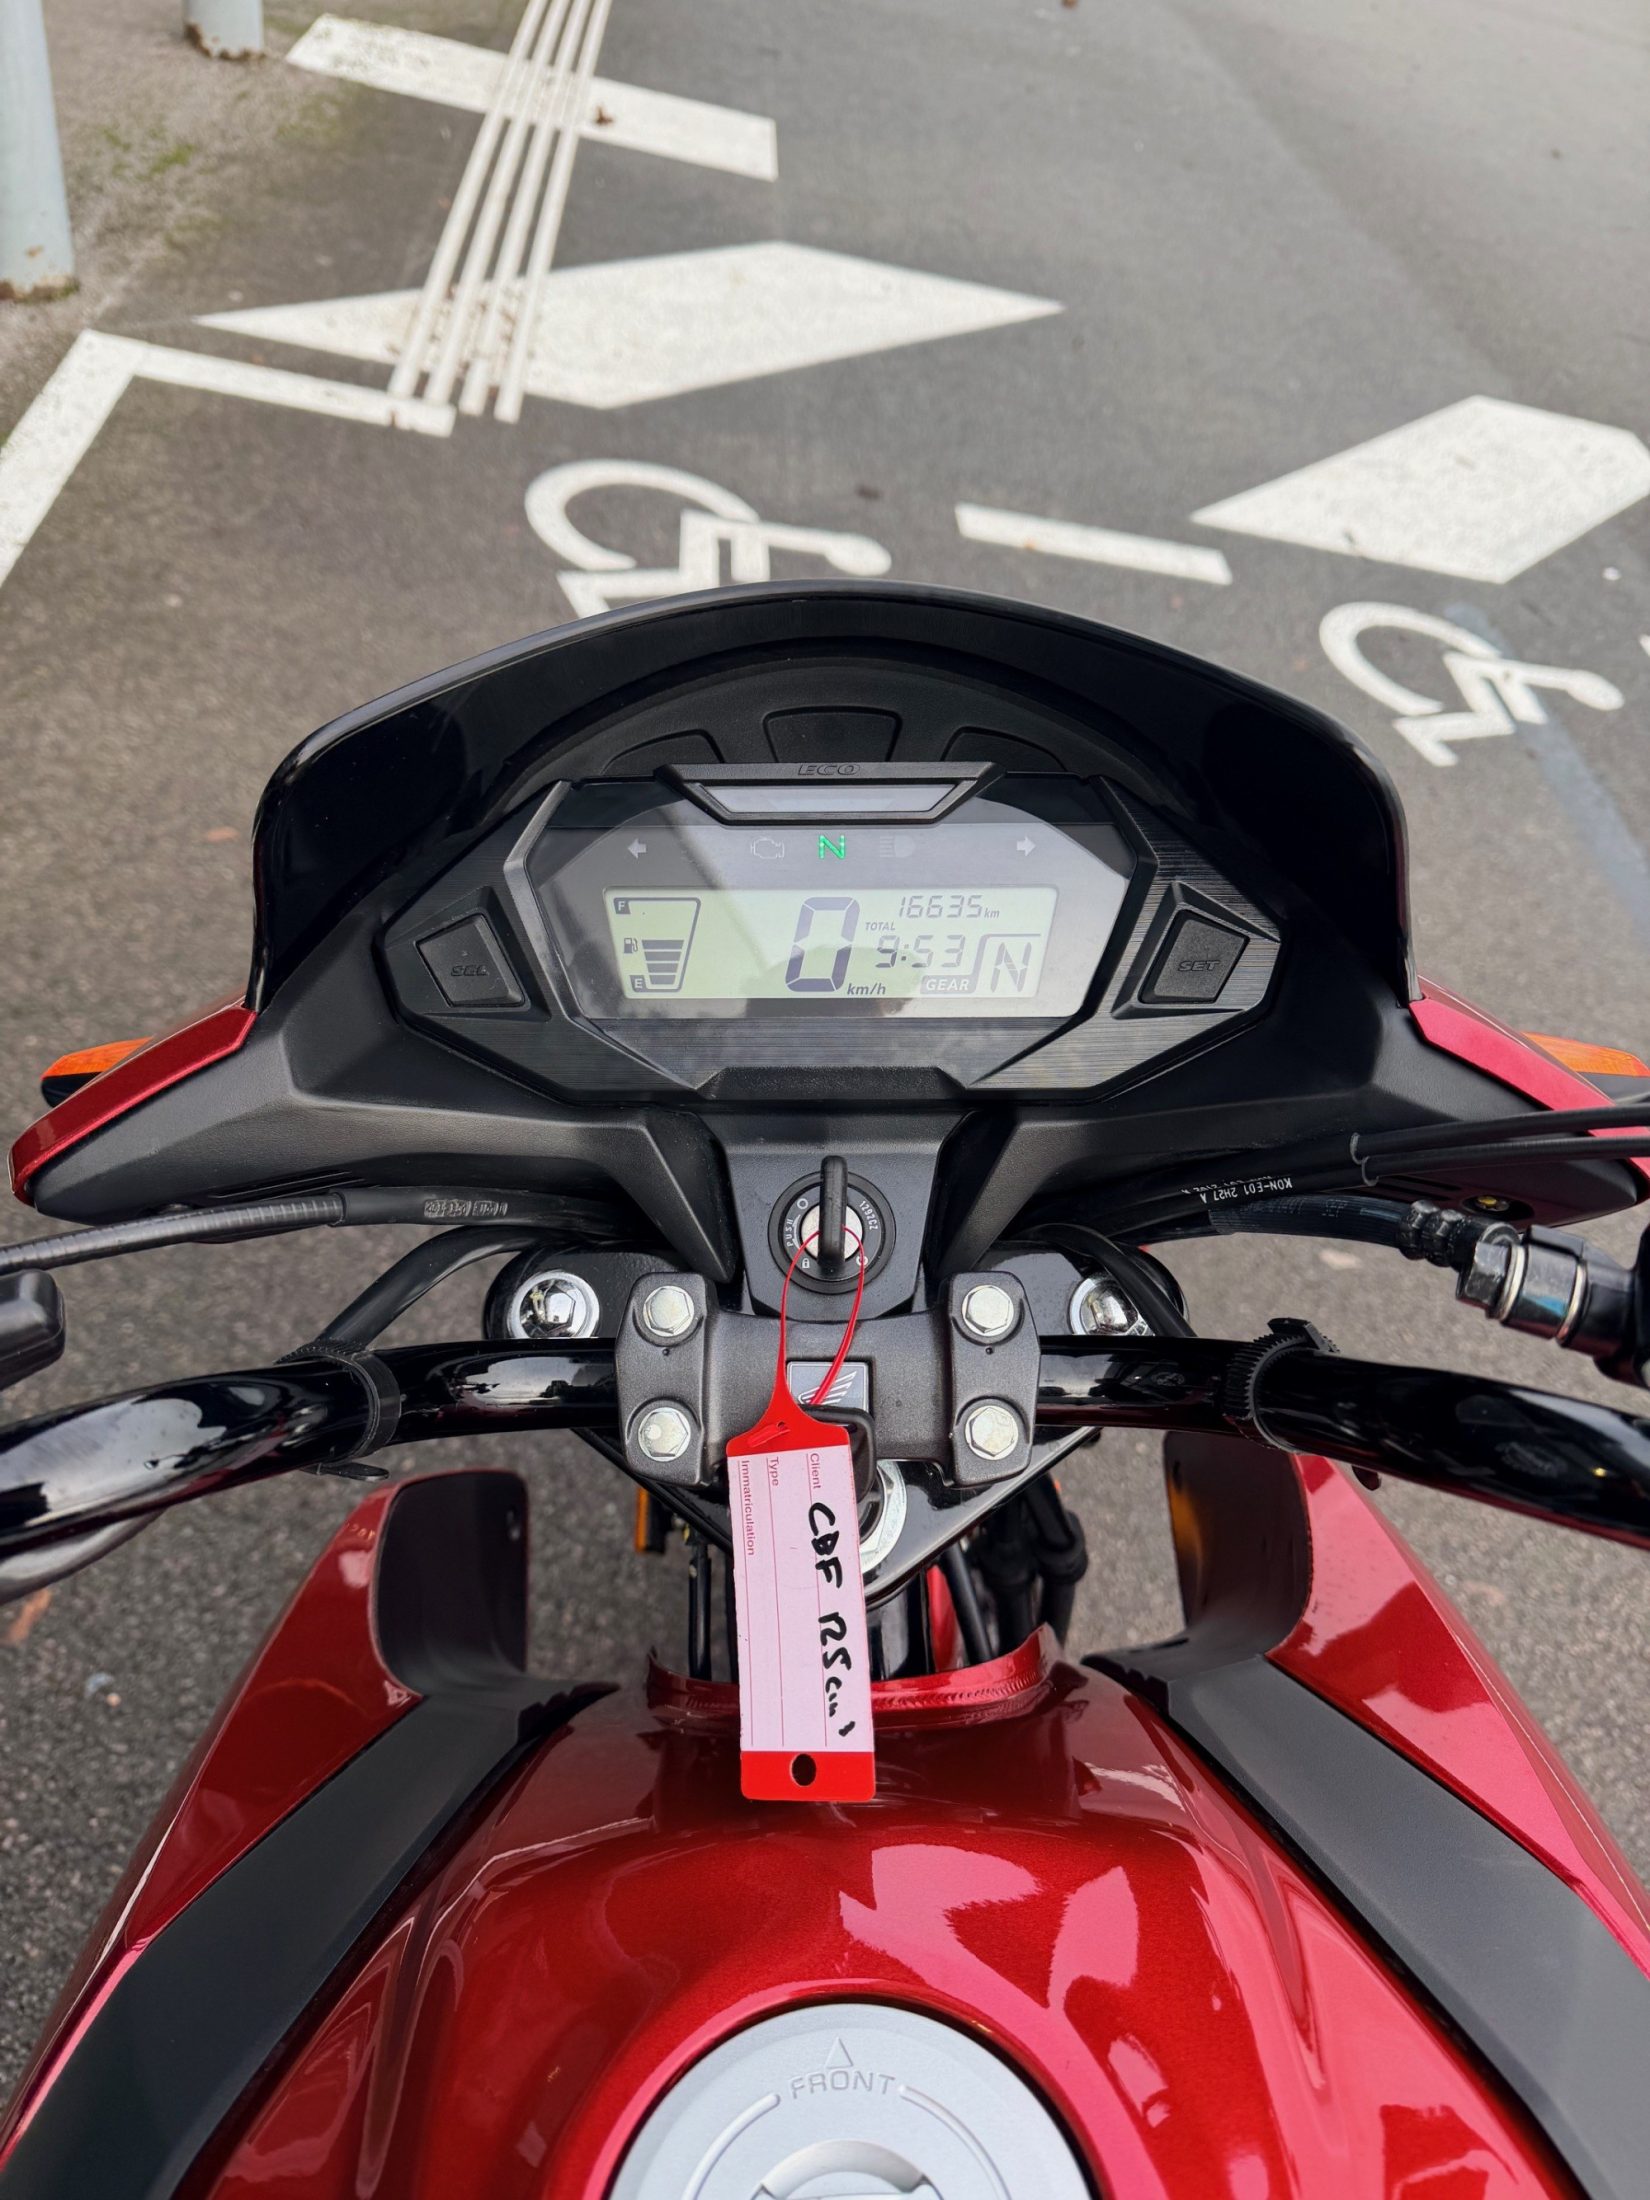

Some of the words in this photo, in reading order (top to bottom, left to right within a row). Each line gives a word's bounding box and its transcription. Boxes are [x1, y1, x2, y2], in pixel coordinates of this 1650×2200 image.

[798, 763, 861, 776] ECO
[818, 833, 846, 860] N
[899, 895, 982, 918] 16635
[984, 908, 1000, 919] km
[865, 921, 896, 932] TOTAL
[785, 897, 860, 992] 0
[875, 934, 966, 968] 9:53
[451, 964, 488, 977] SEL
[990, 942, 1032, 993] N
[1178, 960, 1220, 972] SET
[847, 982, 887, 995] km/h
[926, 978, 970, 991] GEAR
[786, 1218, 794, 1248] PUSH
[770, 1457, 780, 1487] Type
[809, 1452, 822, 1490] Client
[741, 1460, 755, 1556] Immatriculation
[808, 1502, 843, 1589] CBF
[790, 2070, 895, 2099] FRONT
